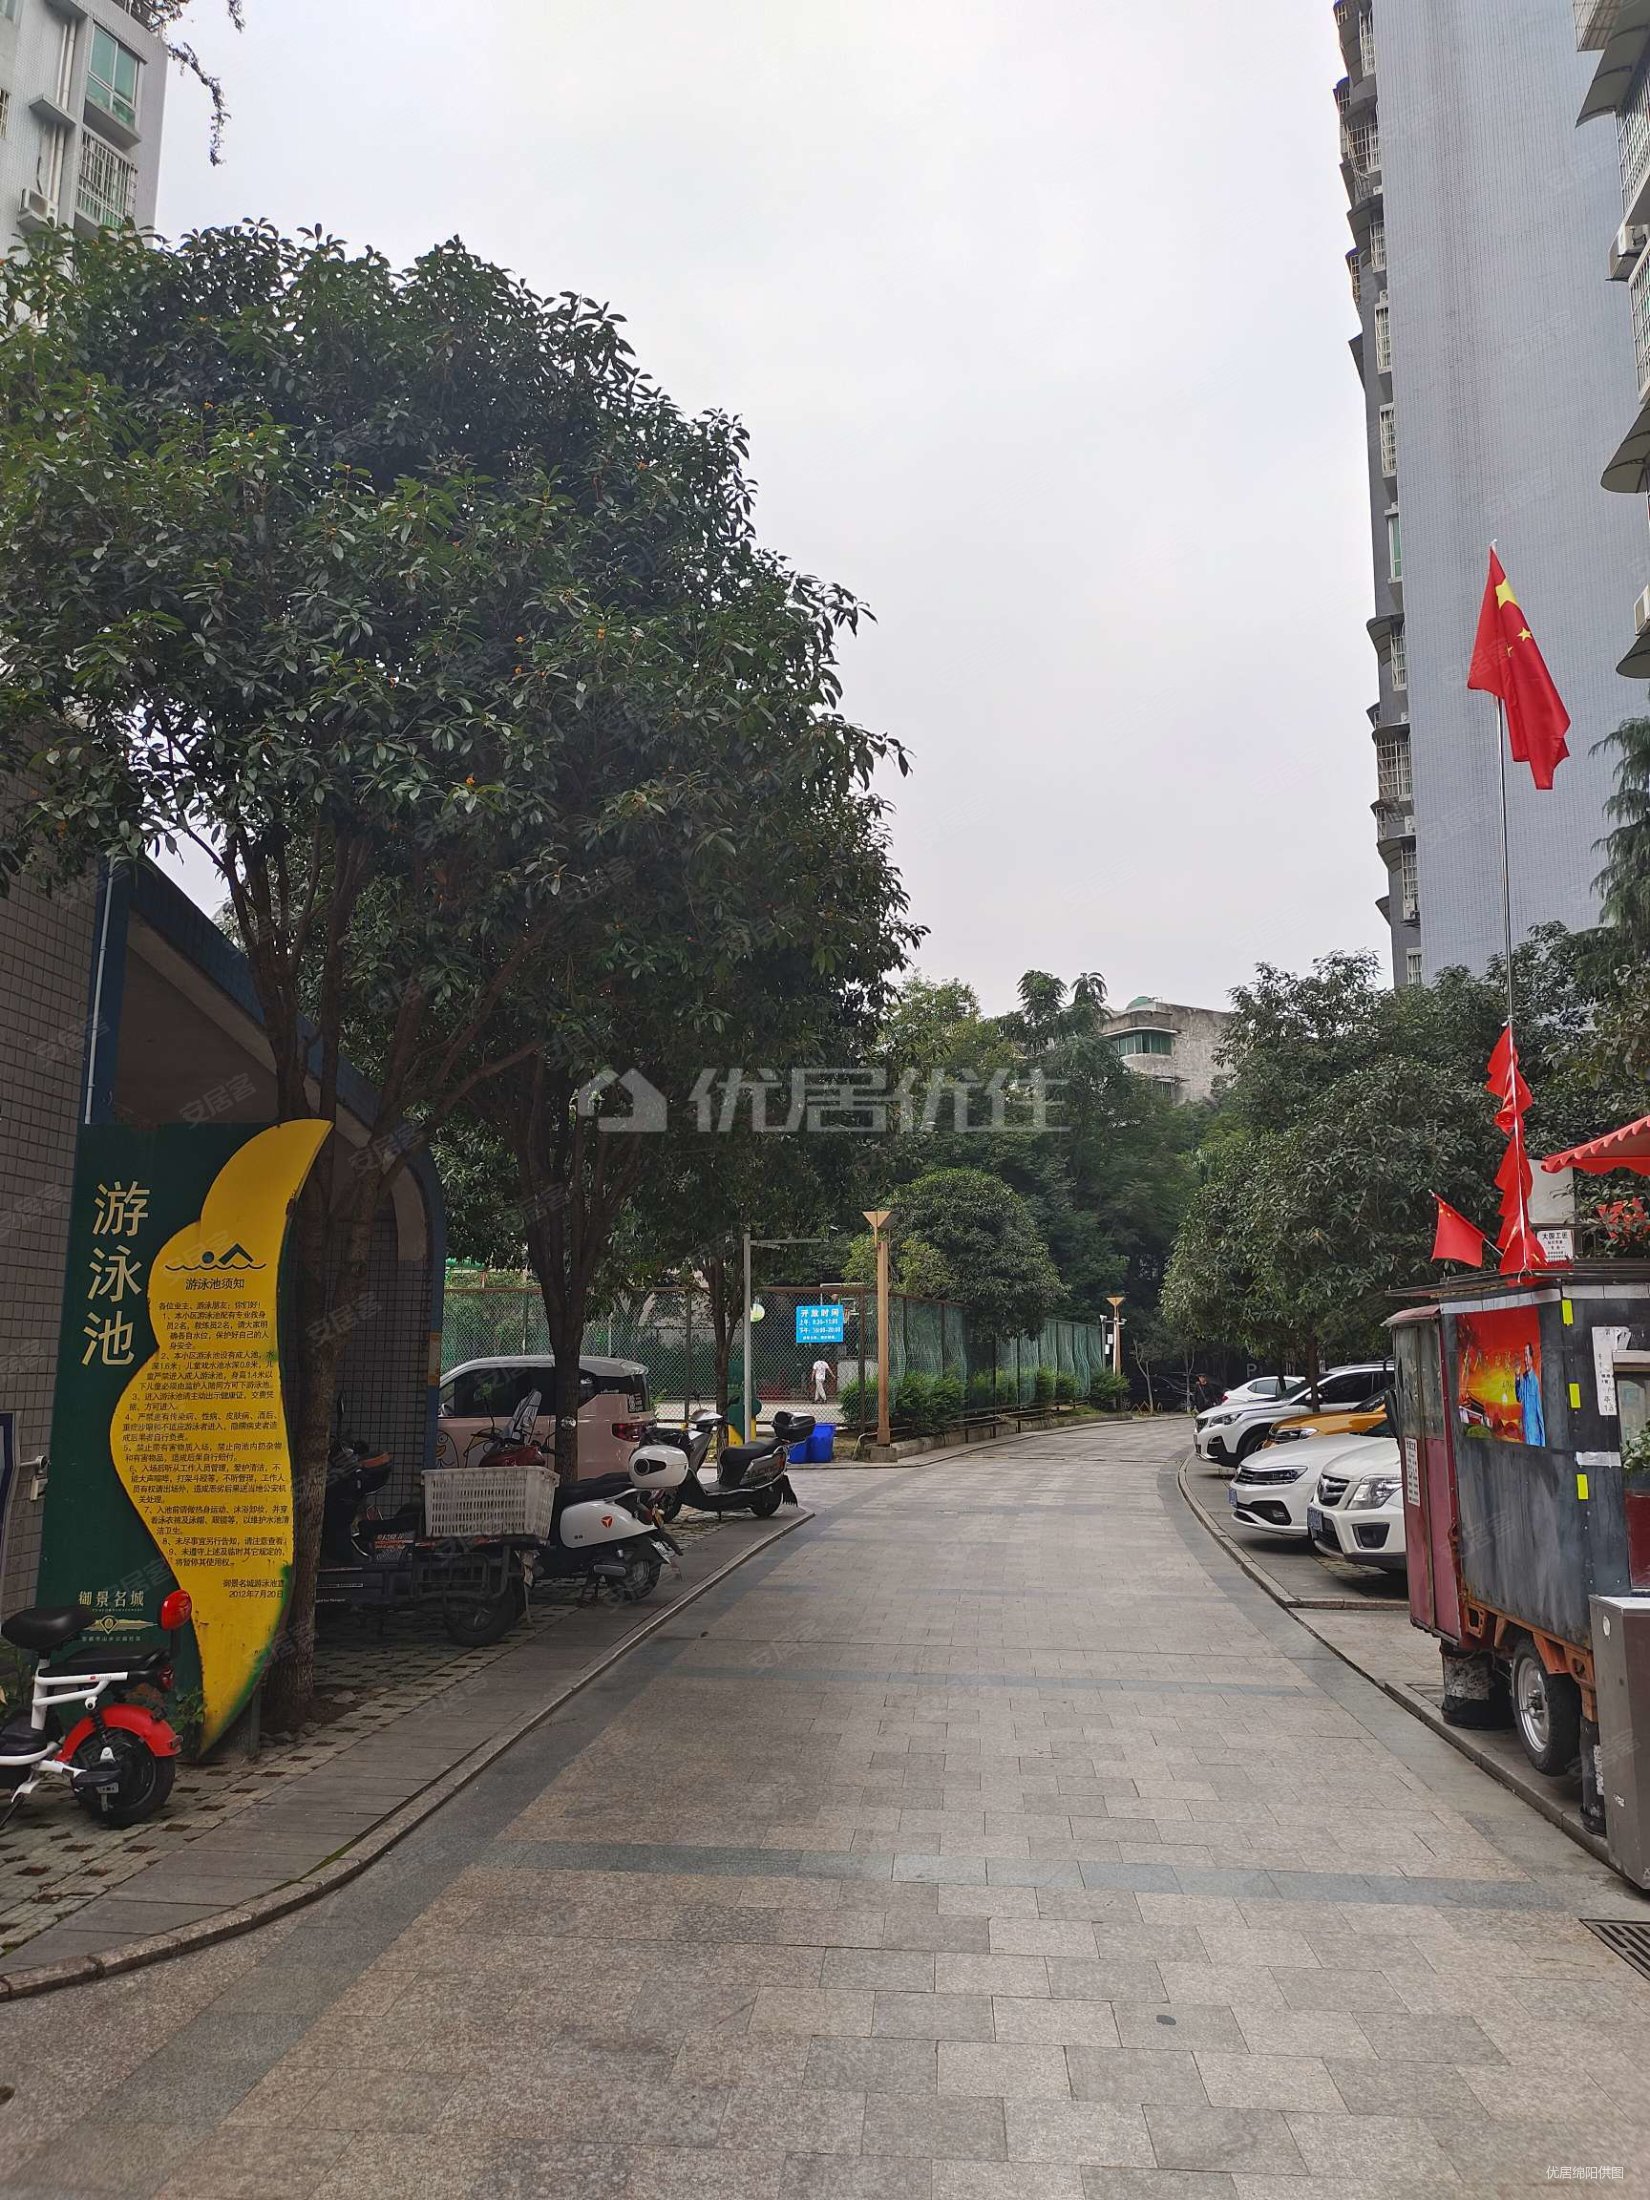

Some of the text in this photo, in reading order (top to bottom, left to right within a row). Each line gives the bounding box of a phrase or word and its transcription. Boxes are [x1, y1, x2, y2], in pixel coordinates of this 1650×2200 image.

[81, 1181, 149, 1368] 游泳池
[185, 1277, 245, 1291] 游泳池须知
[78, 1590, 144, 1608] 御景名城
